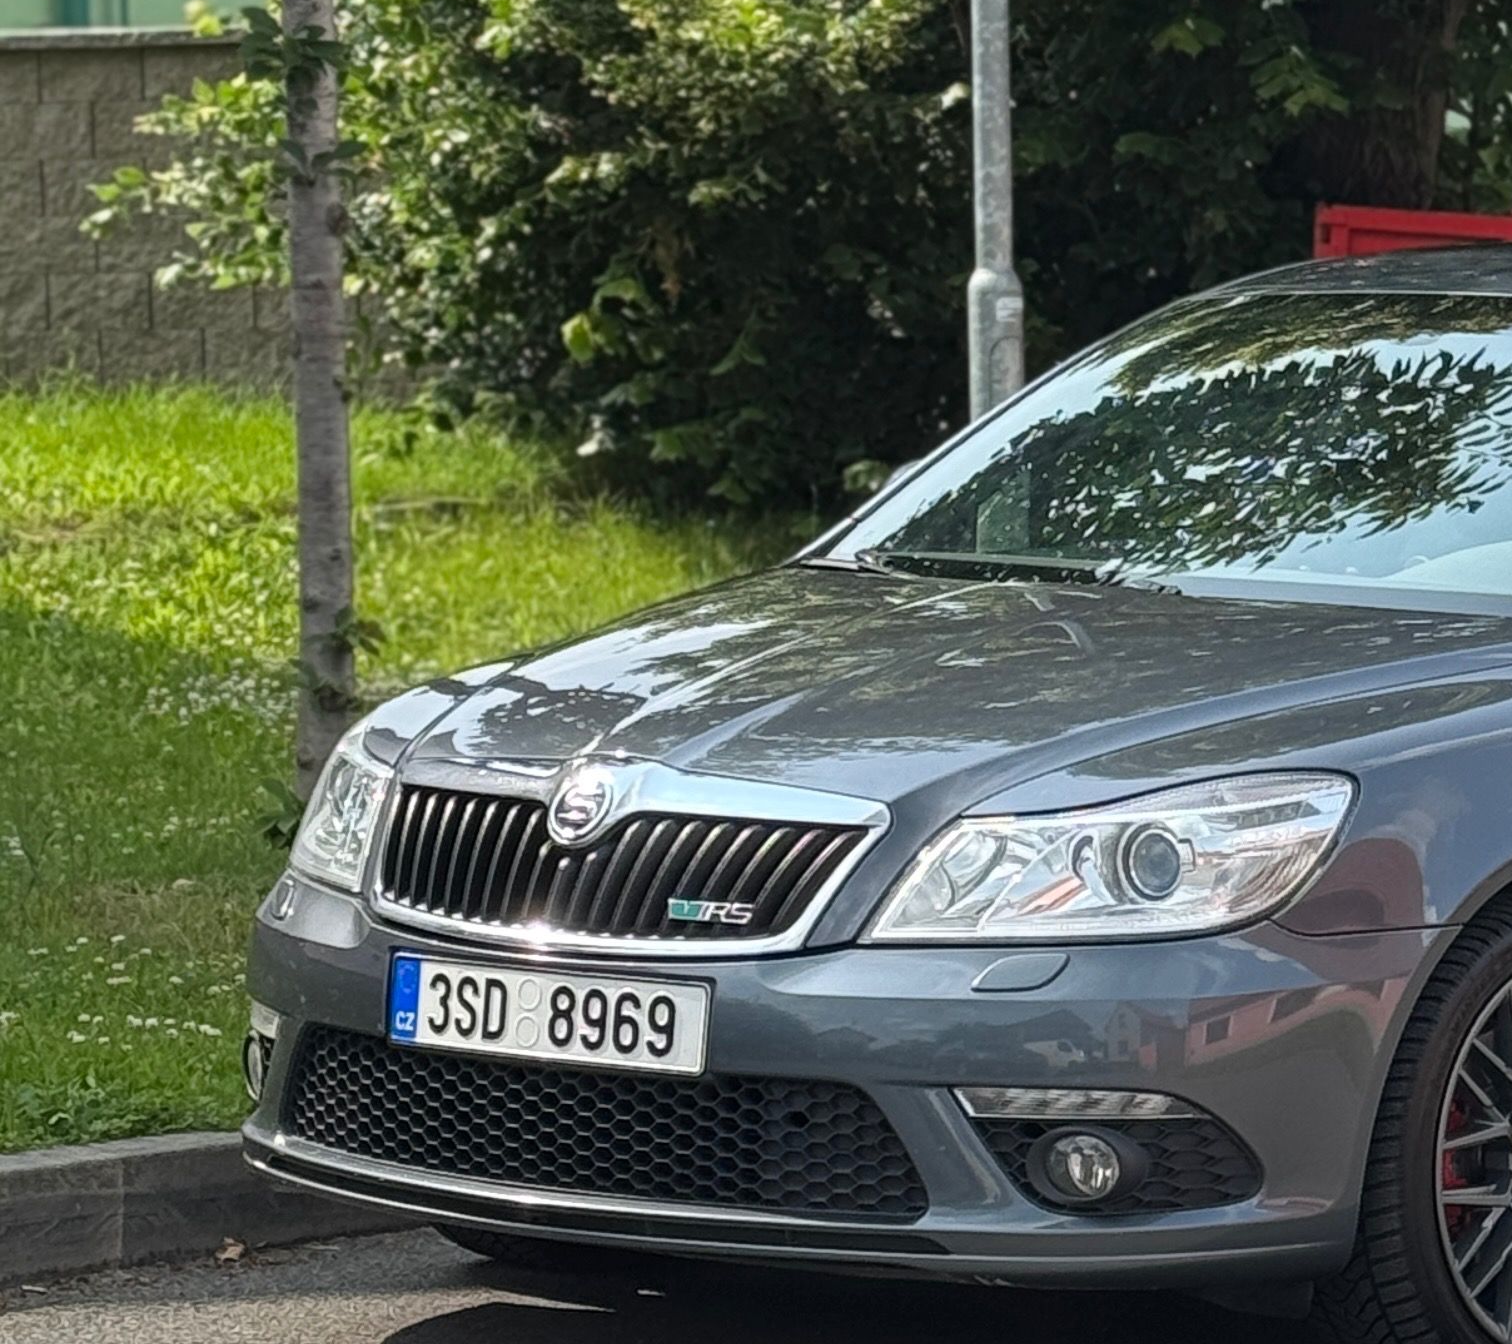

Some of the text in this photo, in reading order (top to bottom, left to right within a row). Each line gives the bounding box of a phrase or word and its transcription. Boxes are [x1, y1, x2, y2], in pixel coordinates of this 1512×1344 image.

[395, 1010, 415, 1031] CZ
[428, 972, 677, 1058] 3SD 8969
